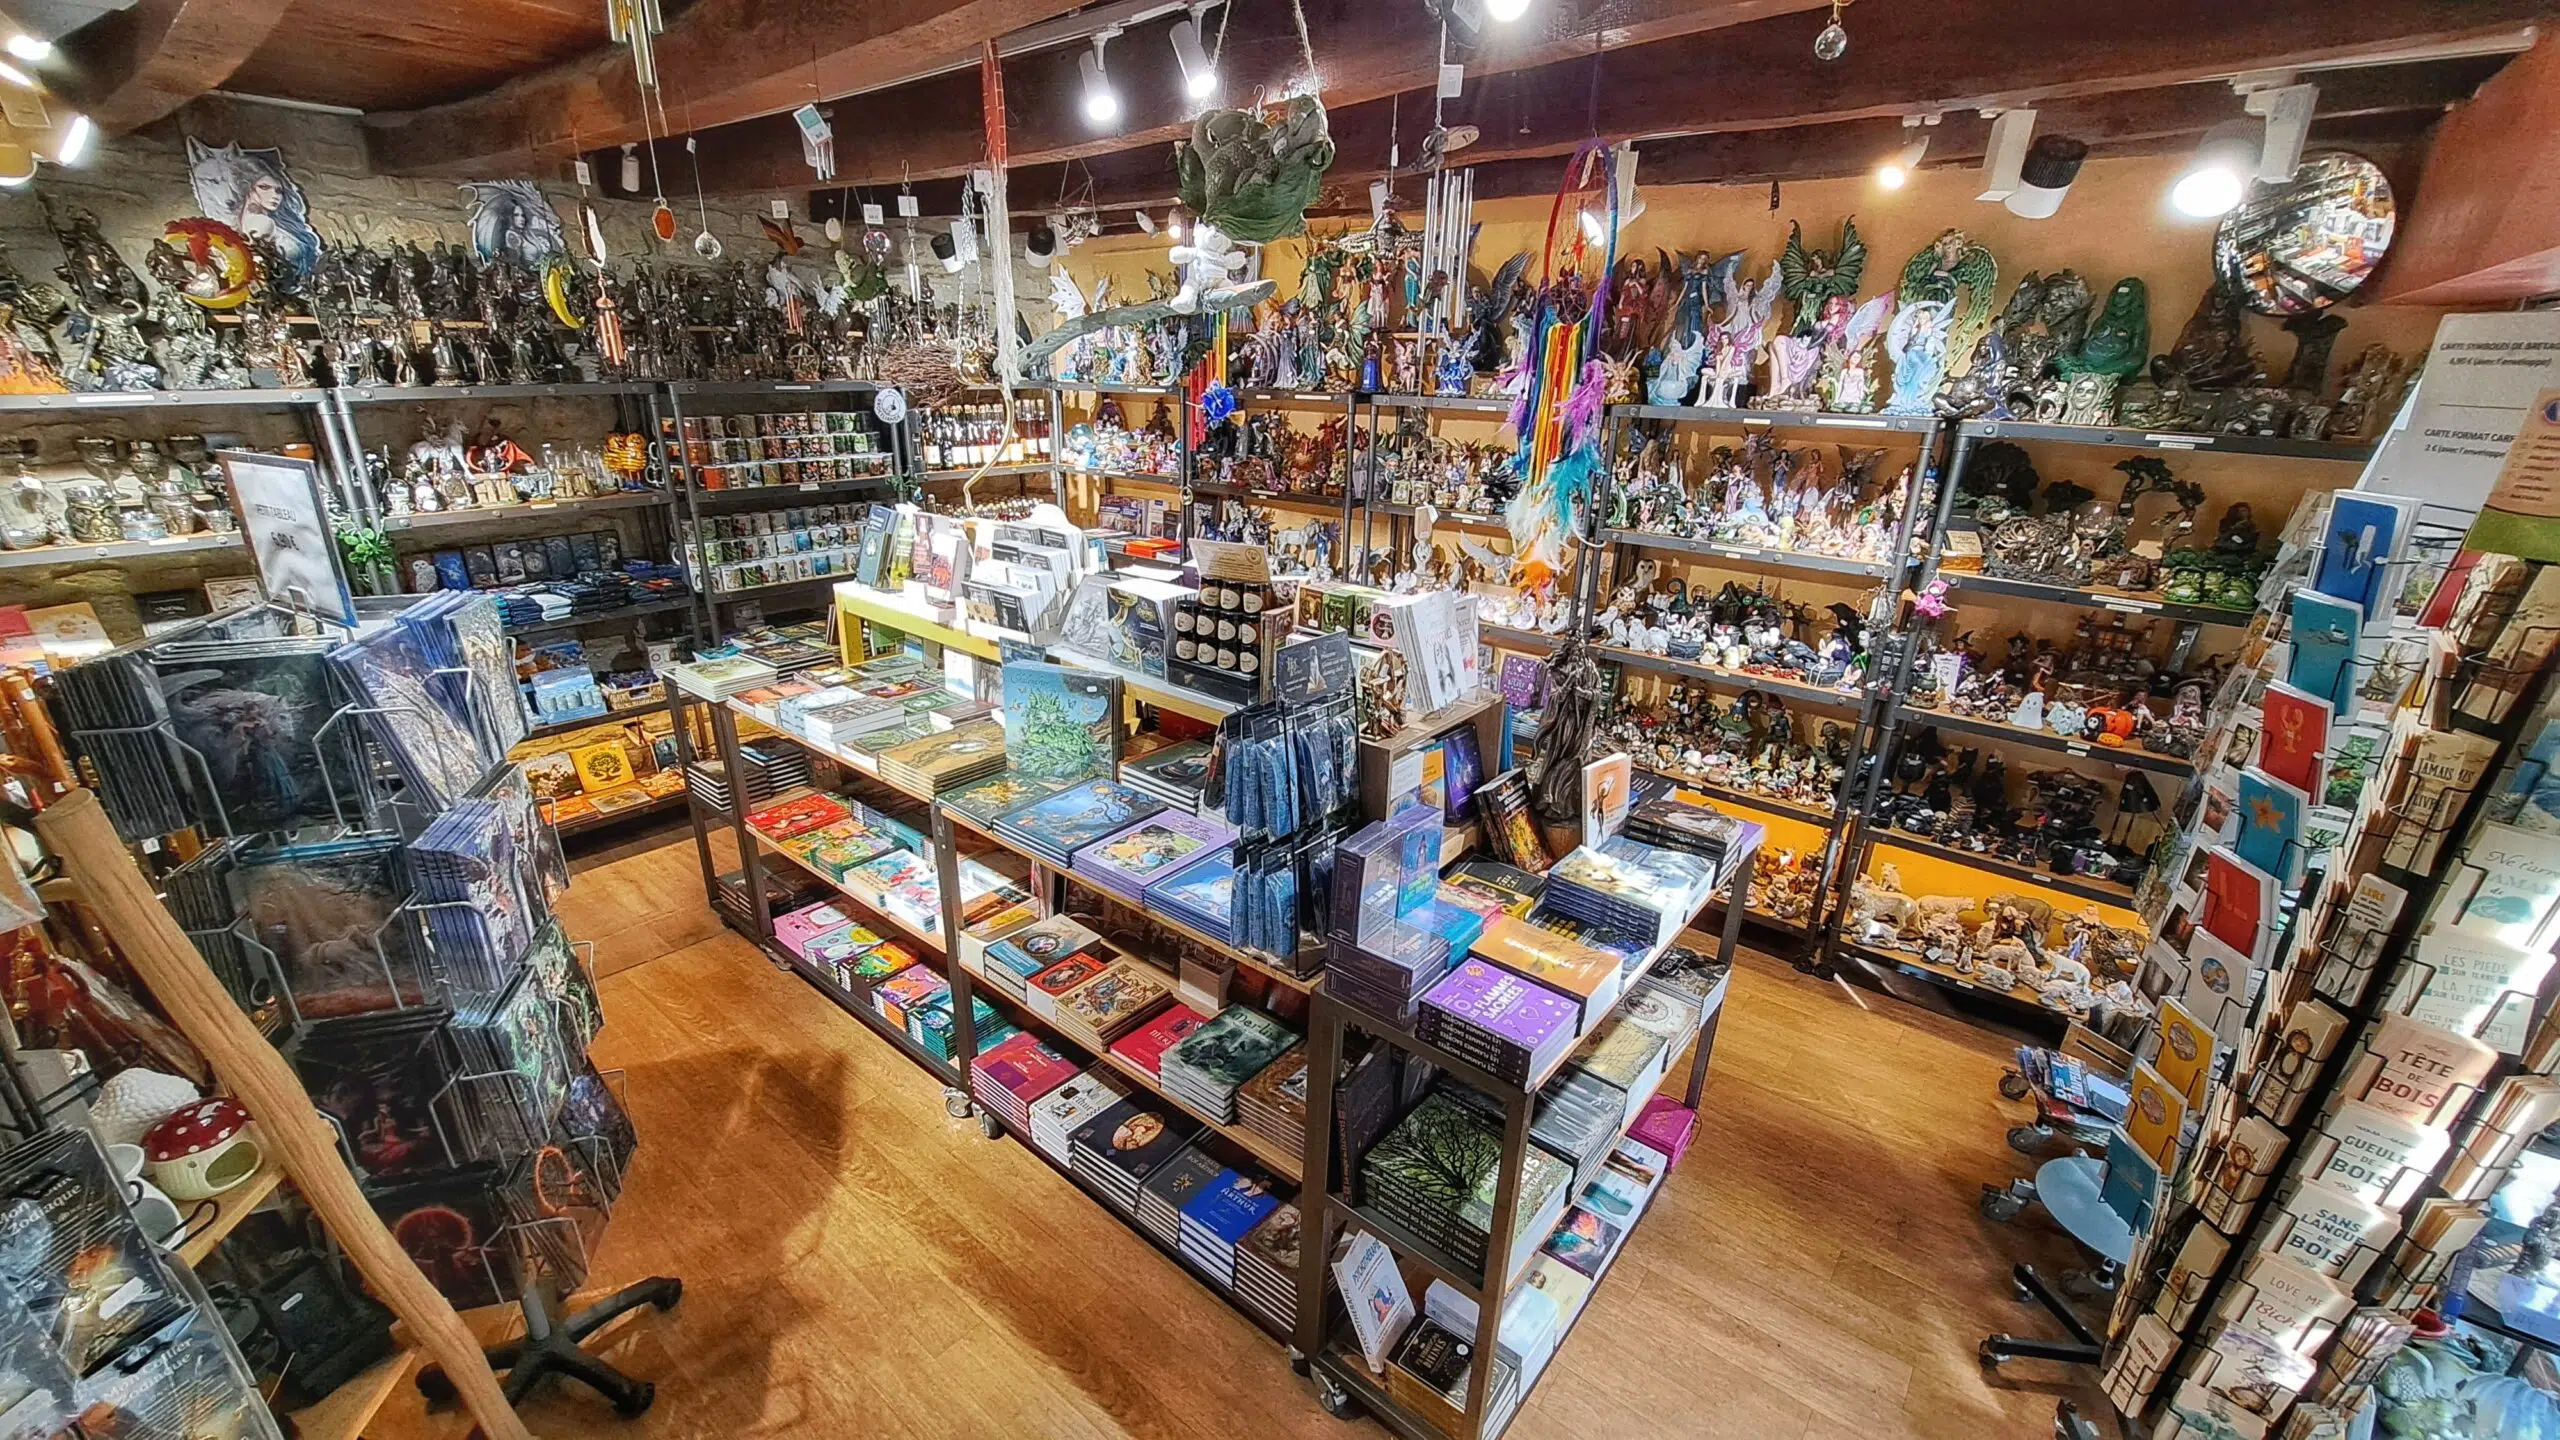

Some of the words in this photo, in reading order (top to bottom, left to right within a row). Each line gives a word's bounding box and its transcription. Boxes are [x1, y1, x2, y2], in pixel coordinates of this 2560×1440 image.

[2424, 428, 2451, 439] CARTE
[2451, 430, 2490, 441] FORMAT
[2425, 443, 2431, 452] 2
[2419, 757, 2454, 781] JAMAIS
[2444, 954, 2466, 968] LES
[2473, 959, 2509, 975] PIEDS
[1474, 974, 1516, 1009] FLAMMES
[2442, 981, 2457, 992] LA
[2399, 1050, 2455, 1078] TÊTE
[2407, 1072, 2424, 1082] DE
[2375, 1077, 2438, 1108] BOIS
[2344, 1135, 2408, 1164] GUEULE
[2360, 1155, 2376, 1165] DE
[2329, 1158, 2392, 1189] BOIS
[1221, 1187, 1256, 1215] ARTHUR
[2300, 1214, 2366, 1247] LANGUE
[2316, 1208, 2363, 1232] SANS
[2287, 1234, 2347, 1267] BOIS
[2317, 1235, 2332, 1244] DE
[2269, 1277, 2301, 1297] LOVE
[2305, 1295, 2323, 1307] ME
